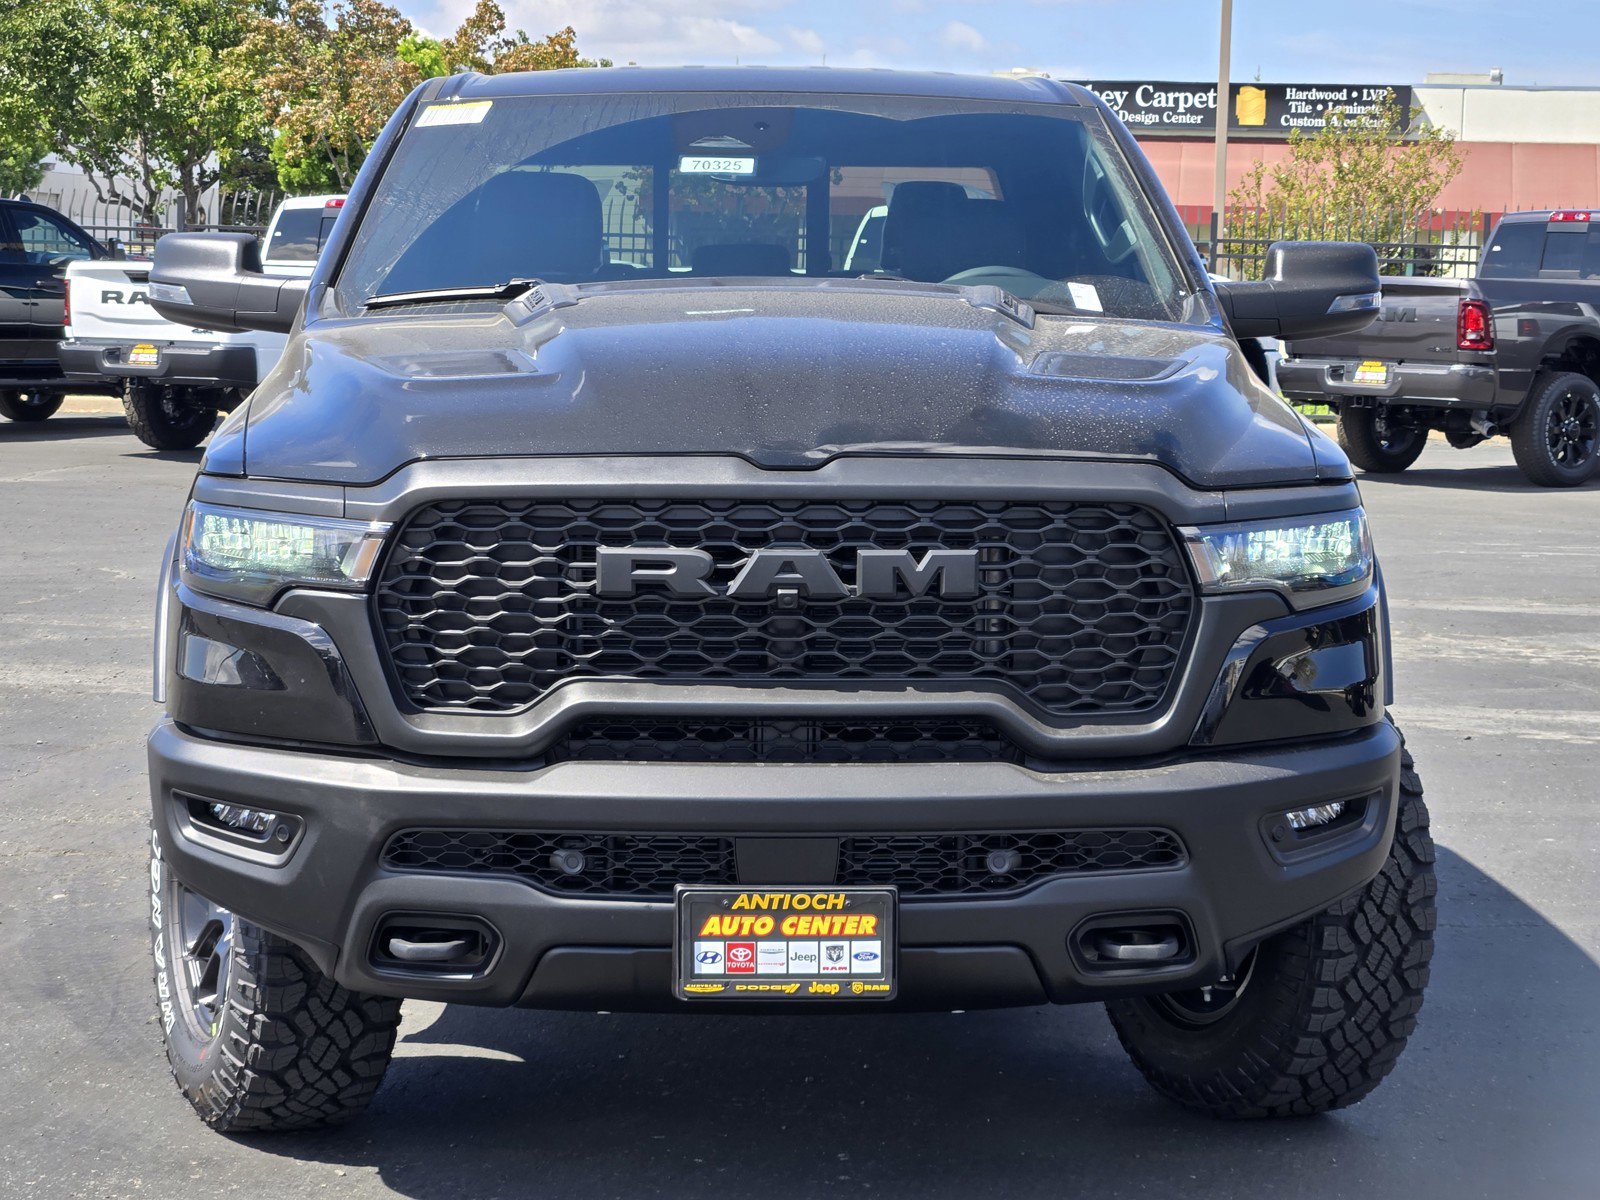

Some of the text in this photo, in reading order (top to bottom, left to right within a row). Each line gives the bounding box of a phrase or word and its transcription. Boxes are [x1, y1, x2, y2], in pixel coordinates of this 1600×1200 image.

[1135, 84, 1217, 113] Carpet
[1285, 87, 1347, 101] Hardwood
[1289, 101, 1313, 113] Tile
[1118, 110, 1204, 126] Design Center
[1280, 114, 1326, 127] Custom
[1330, 115, 1358, 128] Aea
[692, 160, 742, 171] 70325
[101, 290, 150, 305] RA
[596, 547, 979, 599] RAM
[732, 893, 846, 910] ANTIOCH
[699, 914, 878, 937] AUTO CENTER
[790, 952, 817, 963] Jeep
[808, 981, 840, 995] Jeep
